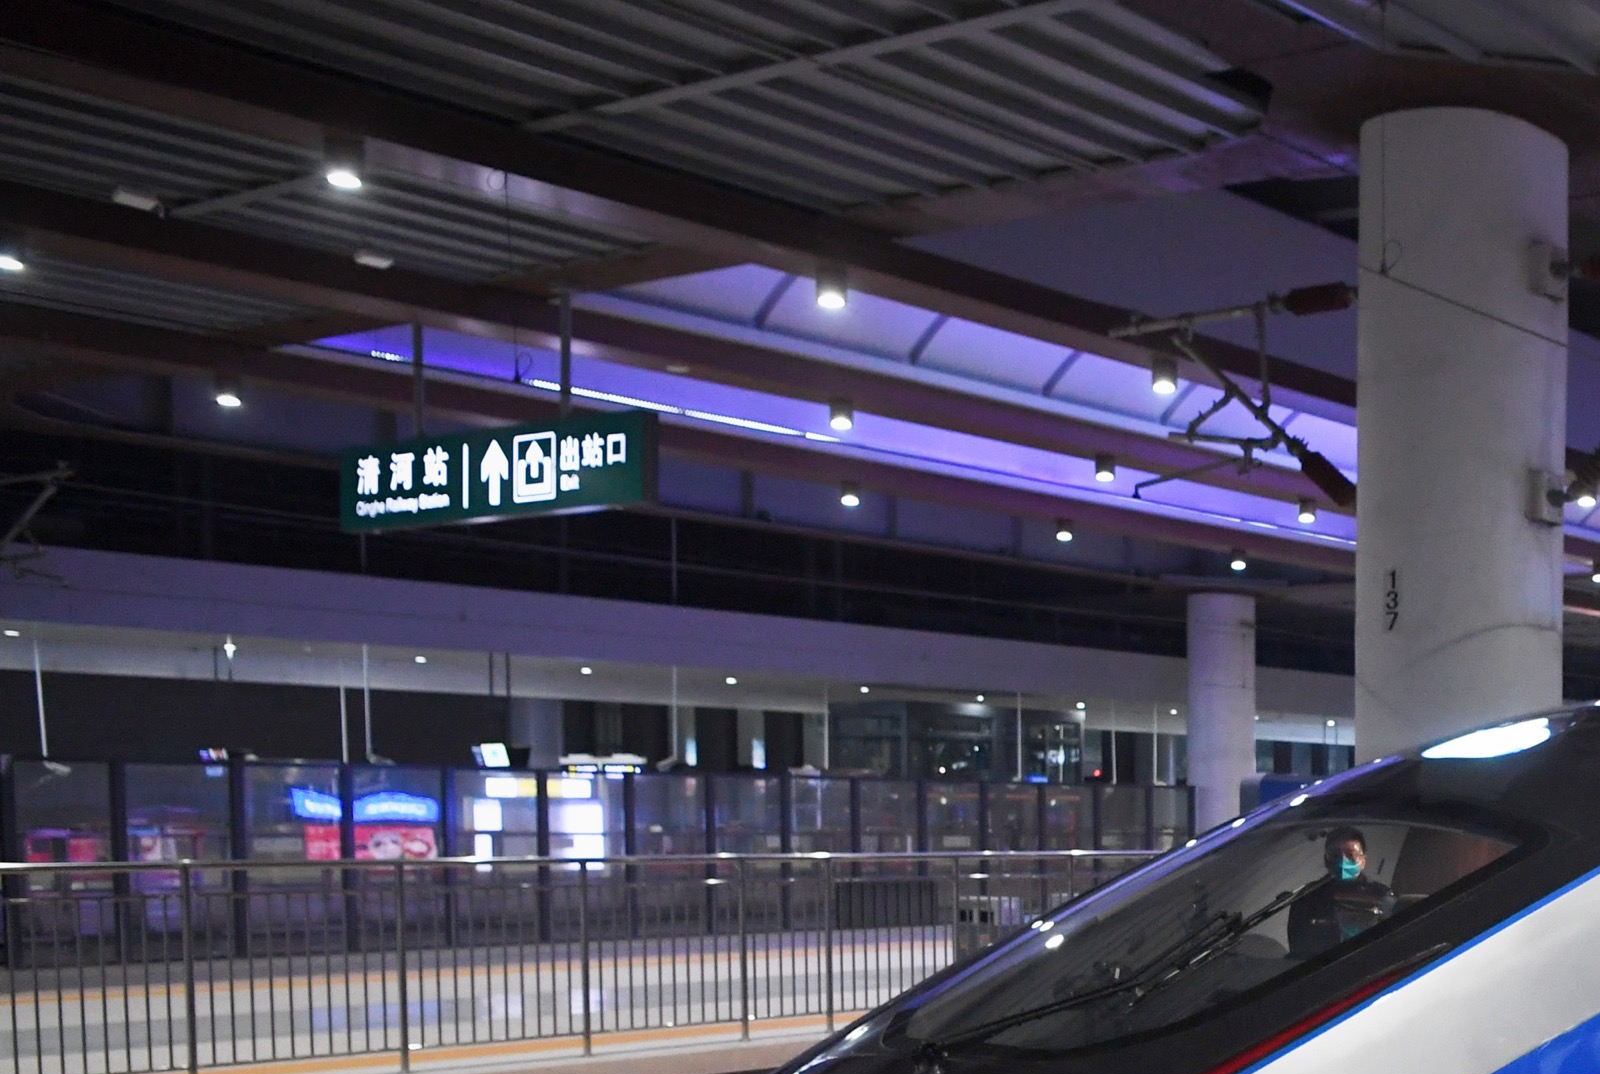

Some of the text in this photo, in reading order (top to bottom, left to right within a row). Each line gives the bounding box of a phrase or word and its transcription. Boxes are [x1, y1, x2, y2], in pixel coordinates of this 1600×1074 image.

[559, 432, 626, 471] 出站口
[1385, 569, 1399, 631] 137
